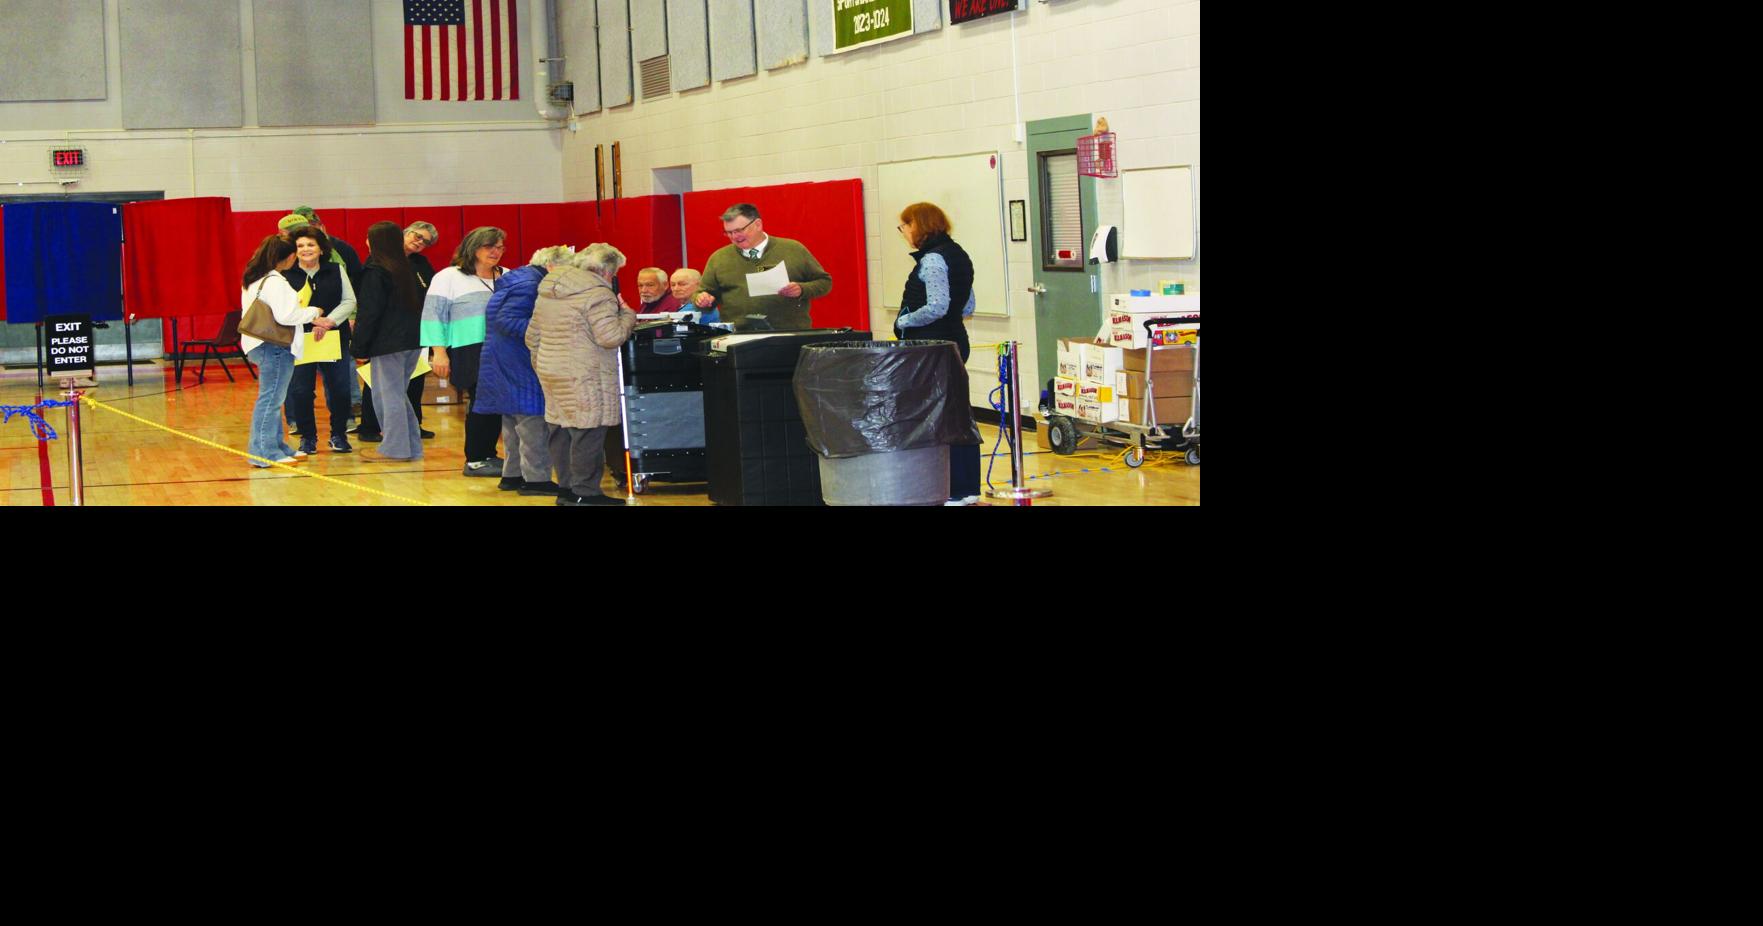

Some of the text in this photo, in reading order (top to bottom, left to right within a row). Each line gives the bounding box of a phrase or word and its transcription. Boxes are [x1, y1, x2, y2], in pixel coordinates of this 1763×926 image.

[55, 151, 80, 166] EXIT
[55, 322, 82, 332] EXIT
[51, 336, 88, 345] PLEASE
[51, 345, 89, 355] DO NOT
[54, 356, 87, 365] ENTER
